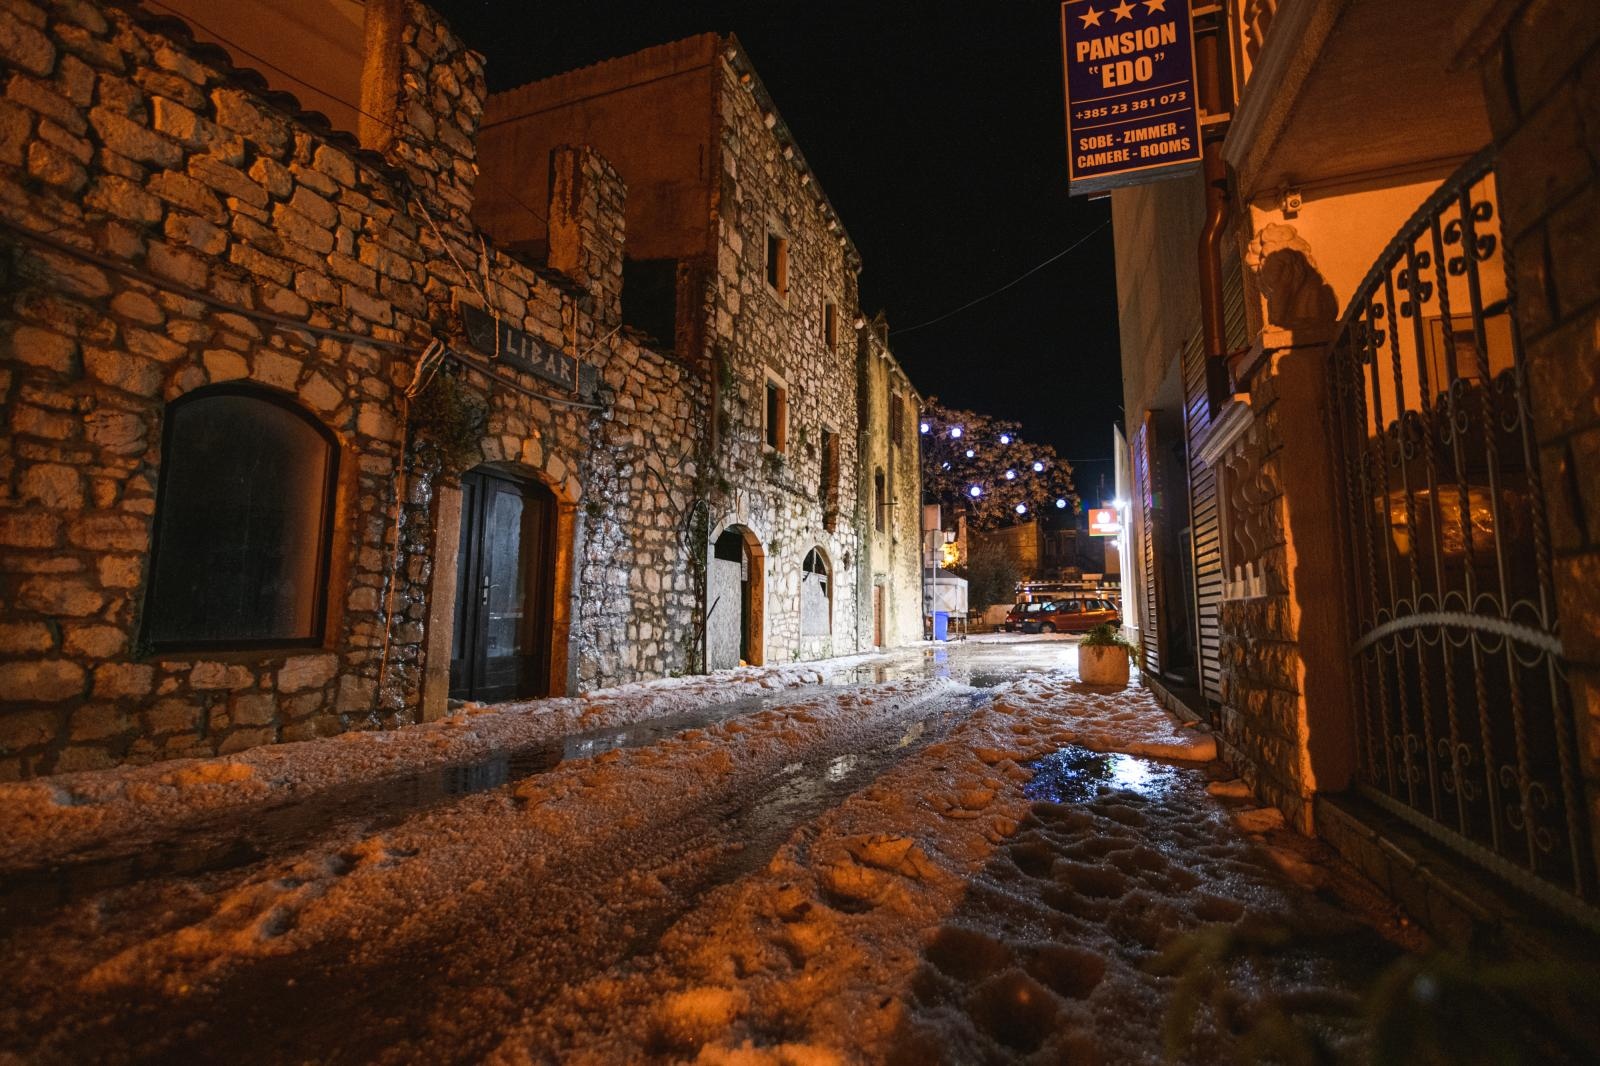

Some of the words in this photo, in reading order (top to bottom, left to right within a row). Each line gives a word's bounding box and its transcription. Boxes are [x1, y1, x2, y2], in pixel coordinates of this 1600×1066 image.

[1076, 21, 1177, 63] PANSION
[1075, 107, 1108, 120] +385
[1111, 103, 1128, 115] 23
[1131, 97, 1156, 111] 381
[1160, 91, 1187, 105] 073
[1079, 134, 1114, 151] SOBE
[1123, 122, 1177, 144] ZIMMER
[1077, 148, 1130, 169] CAMERE
[1140, 137, 1191, 158] ROOMS
[506, 329, 571, 382] LIBAR
